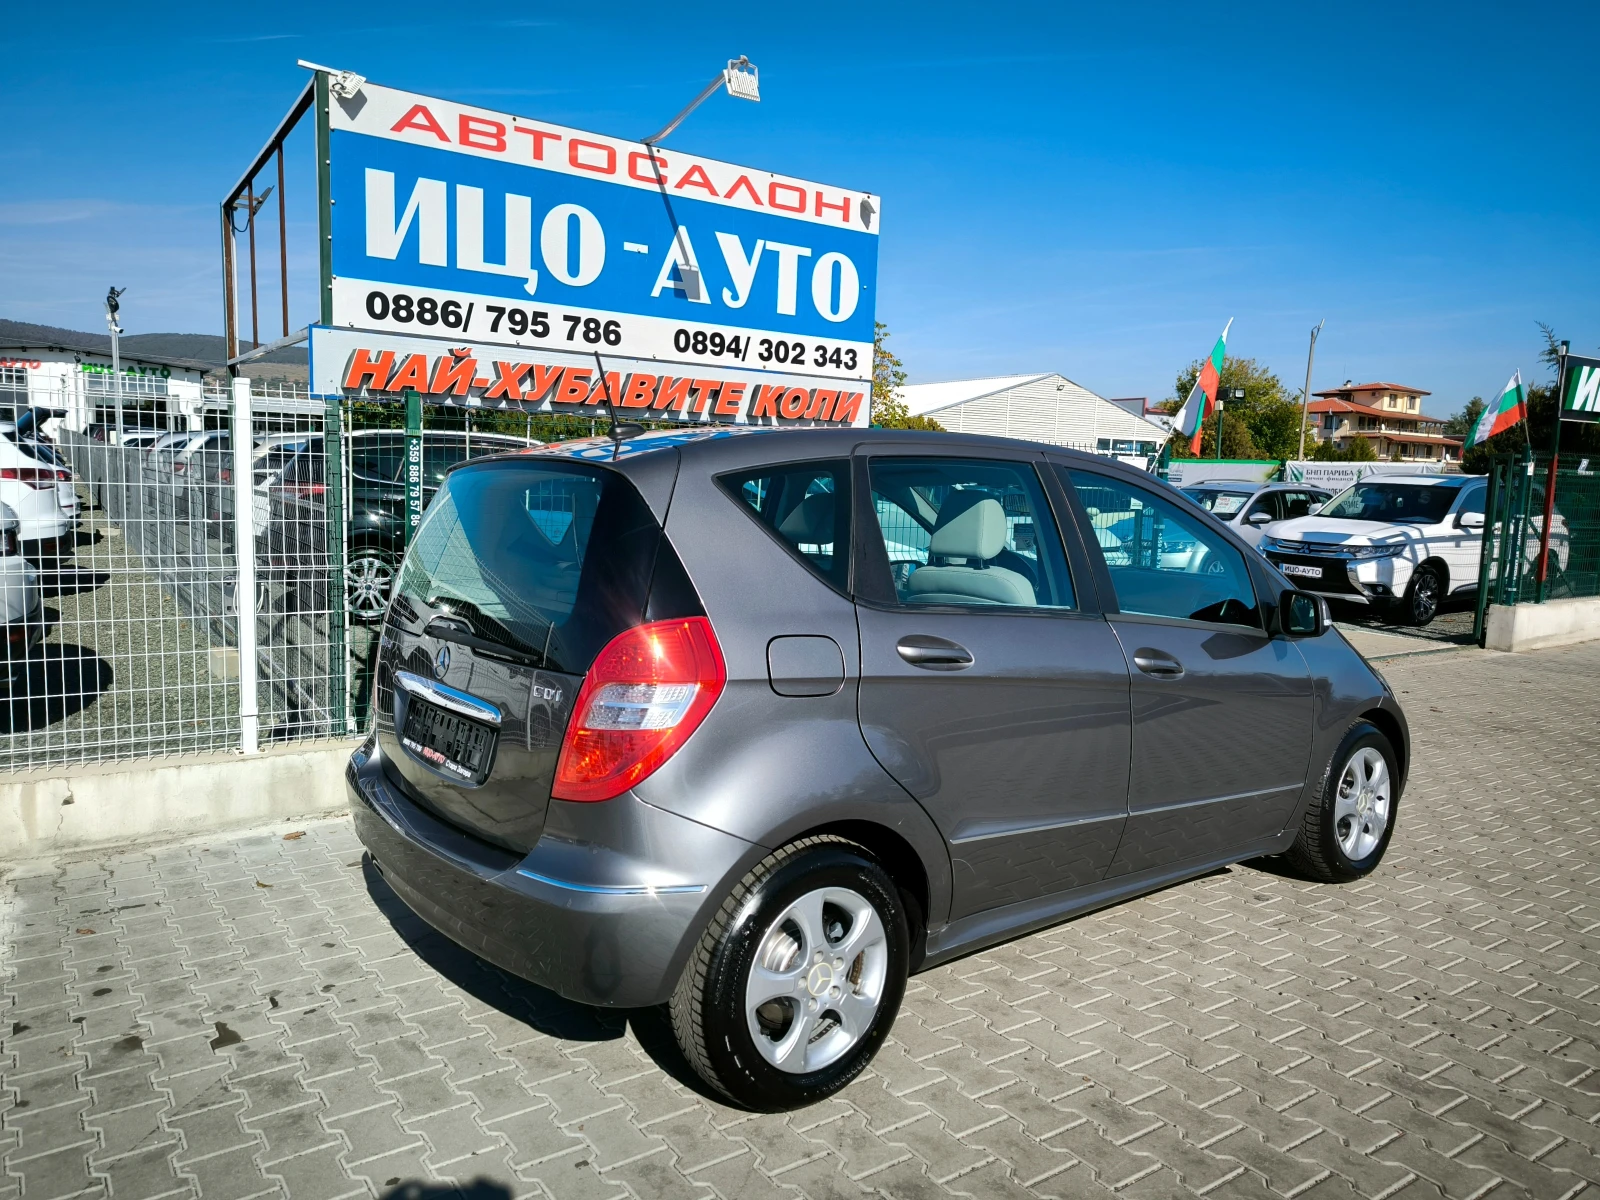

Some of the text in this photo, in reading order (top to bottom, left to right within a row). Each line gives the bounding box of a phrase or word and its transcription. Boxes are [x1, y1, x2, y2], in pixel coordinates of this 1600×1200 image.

[390, 104, 851, 223] АВТОСАЛОН
[365, 291, 622, 346] 0886/ 795 786
[673, 328, 858, 371] 0894/ 302 343
[345, 347, 864, 423] НАЙ-ХУБАВИТЕ КОЛИ
[409, 439, 421, 526] +359 886 79 57 86
[1284, 566, 1321, 575] ИЦО-АУТО
